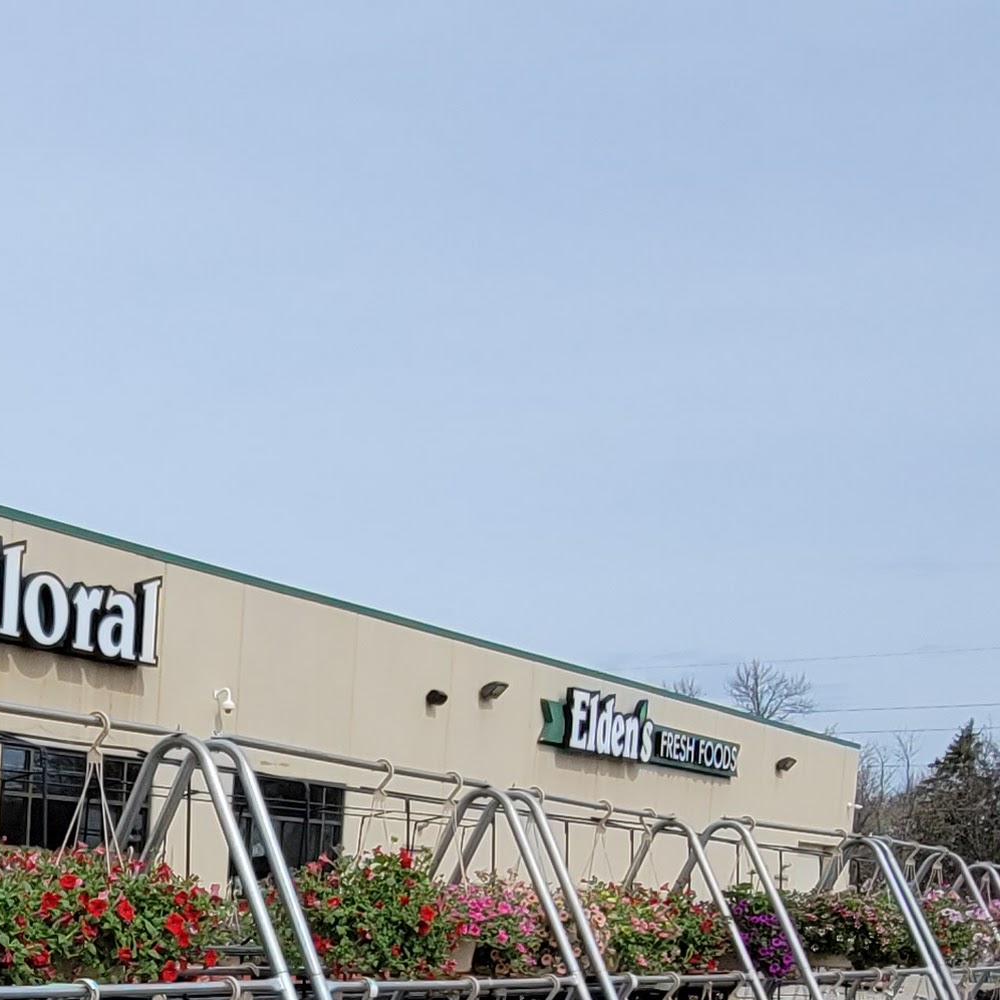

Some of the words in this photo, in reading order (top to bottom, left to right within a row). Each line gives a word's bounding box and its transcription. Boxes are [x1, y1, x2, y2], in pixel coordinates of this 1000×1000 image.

[568, 688, 654, 763] Elden's
[660, 730, 695, 763] FRESH
[698, 739, 739, 772] FOODS
